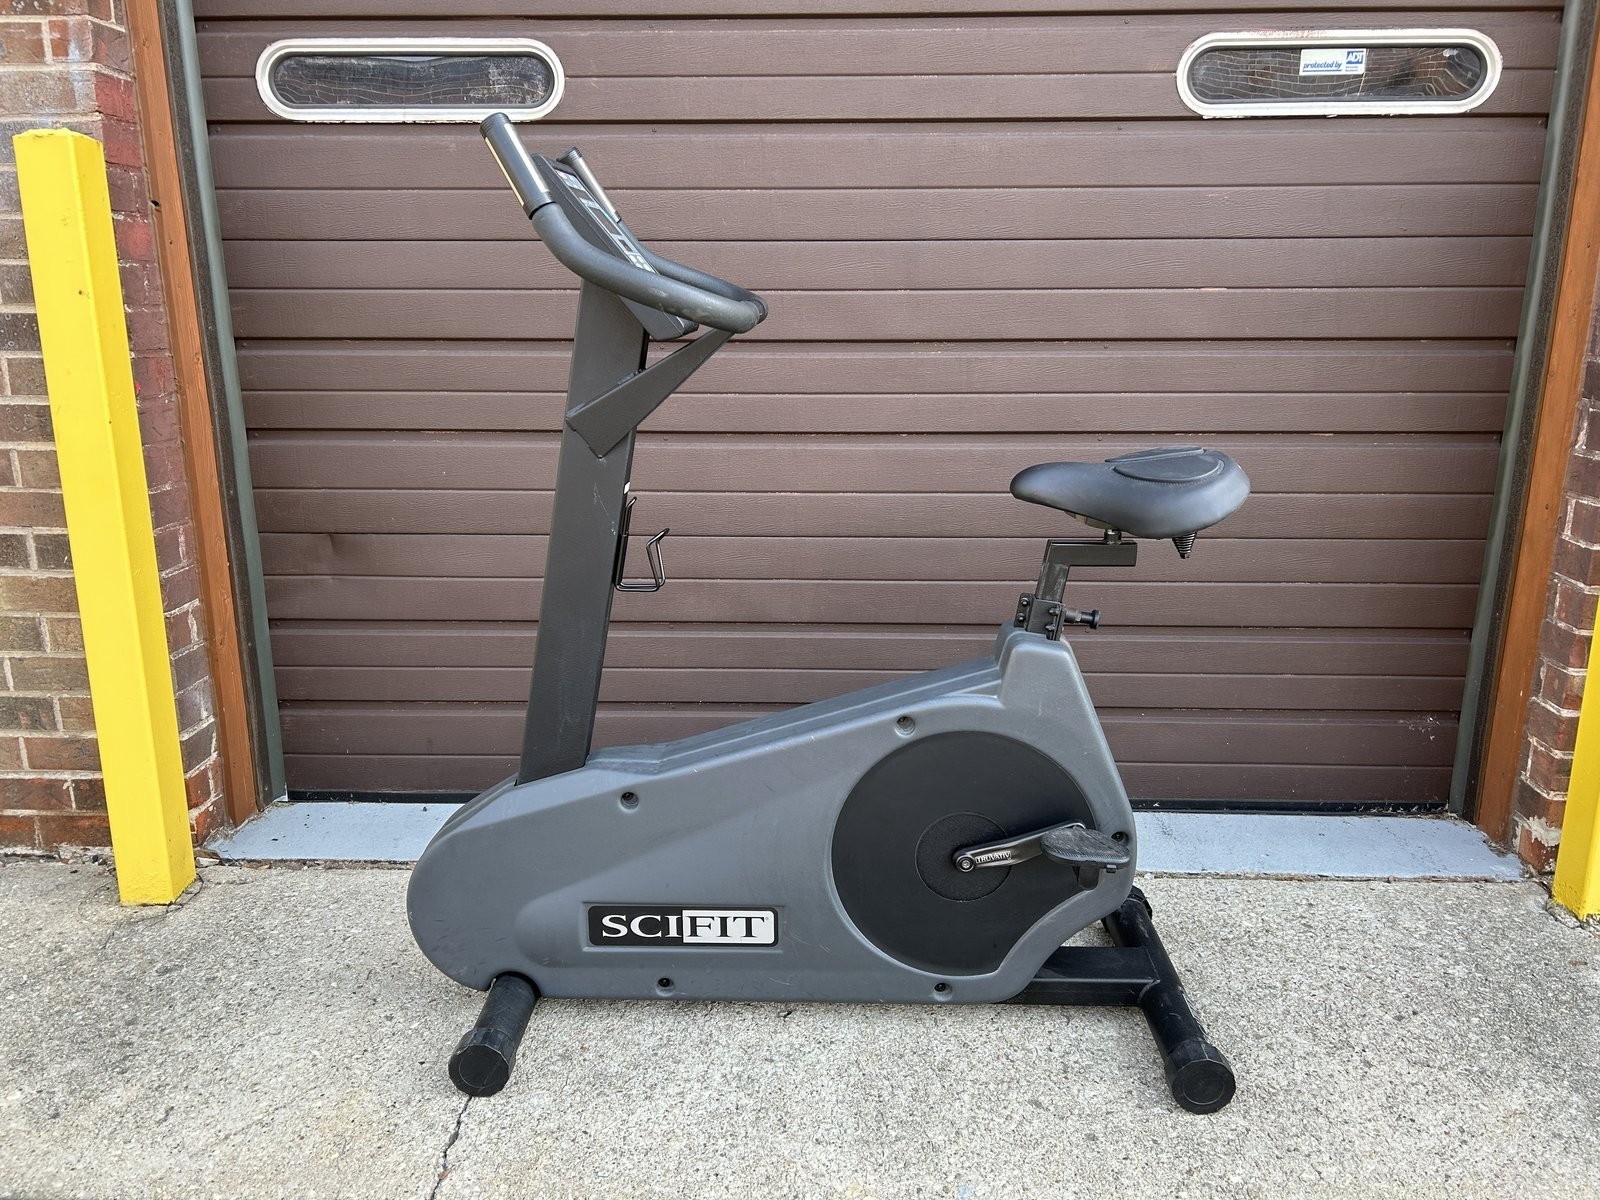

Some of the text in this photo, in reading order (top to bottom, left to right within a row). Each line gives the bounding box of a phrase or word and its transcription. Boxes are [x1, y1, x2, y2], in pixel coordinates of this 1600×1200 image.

[1346, 52, 1364, 63] ADT
[1303, 61, 1342, 69] protected by
[976, 851, 1011, 863] TRUVATIV
[601, 914, 765, 938] SCIFIT
